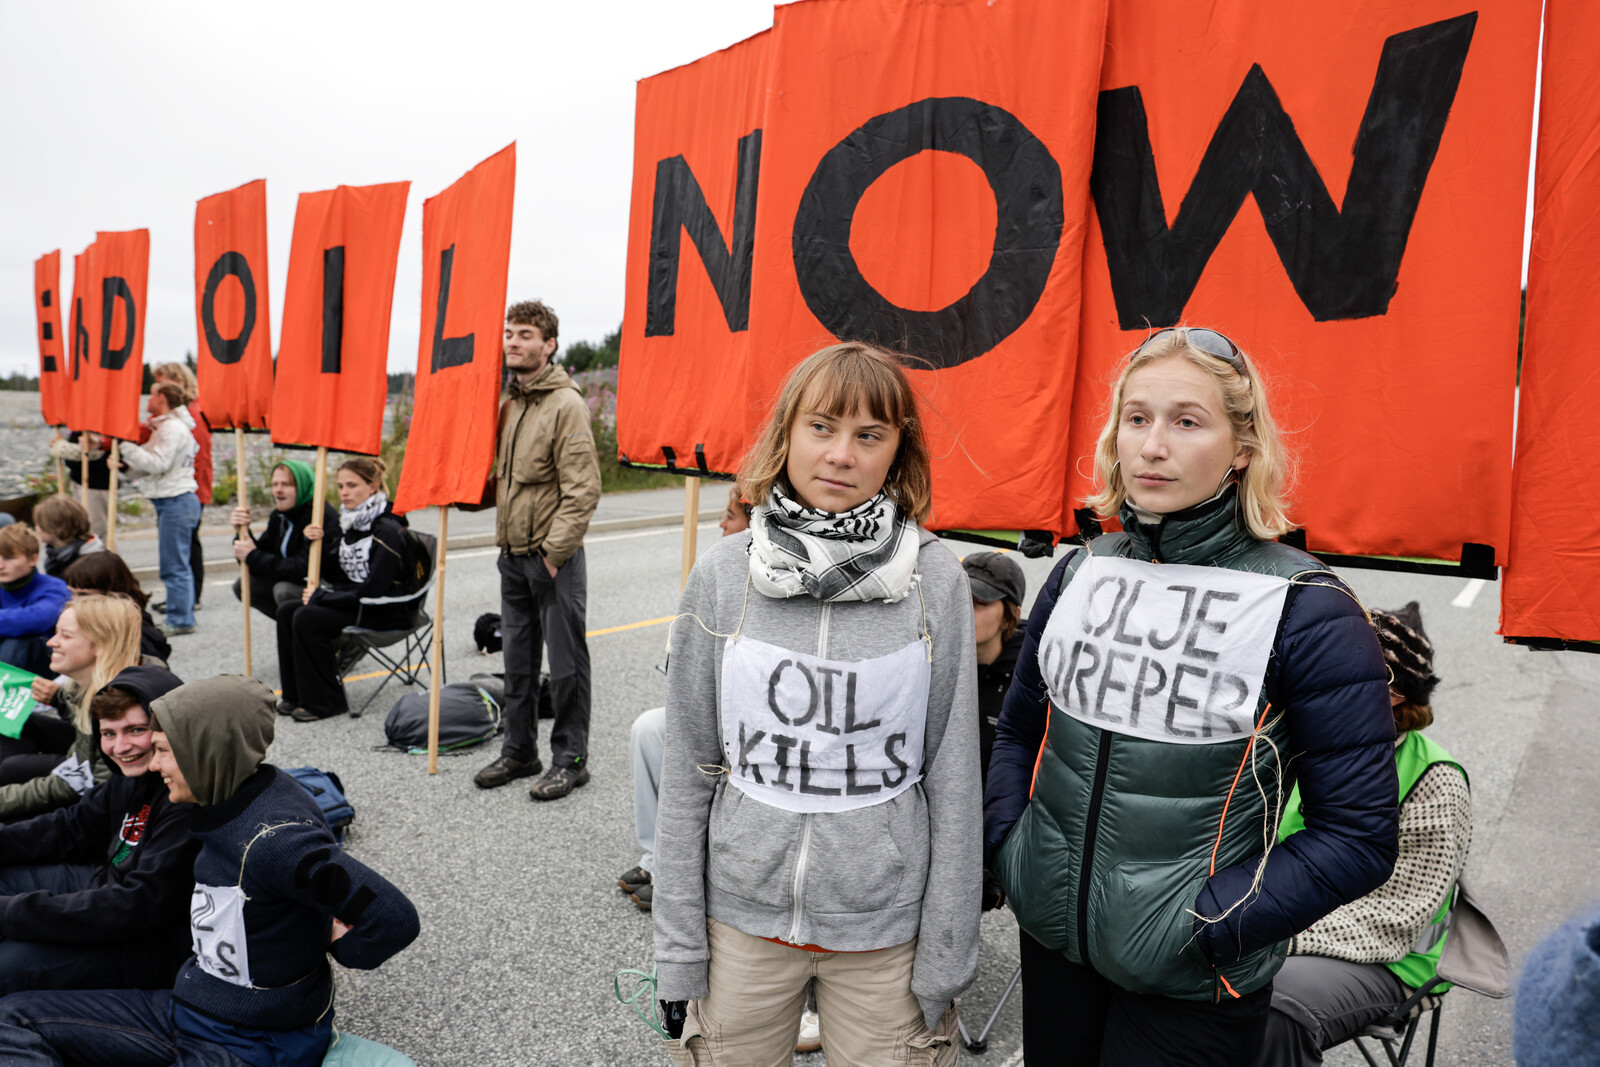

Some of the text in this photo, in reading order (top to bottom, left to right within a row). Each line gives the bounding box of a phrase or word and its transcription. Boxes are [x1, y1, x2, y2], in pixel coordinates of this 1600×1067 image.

[202, 243, 475, 374] OIL
[645, 11, 1478, 370] NOW
[1081, 575, 1240, 663] OLJE
[768, 659, 881, 735] OIL
[1043, 638, 1249, 738] DREPER
[738, 721, 907, 796] KILLS
